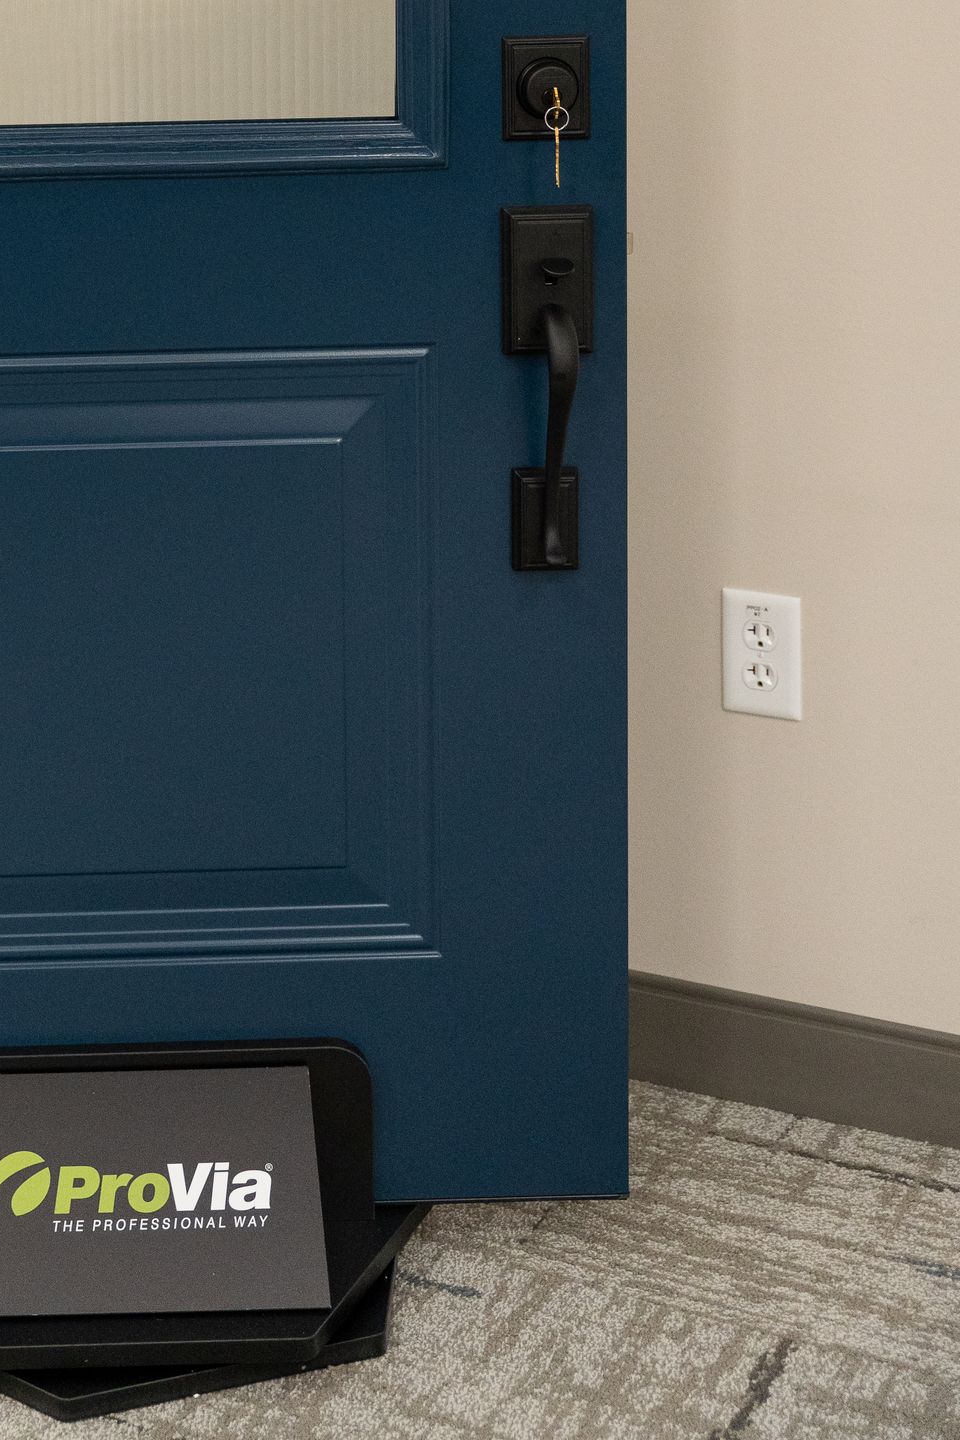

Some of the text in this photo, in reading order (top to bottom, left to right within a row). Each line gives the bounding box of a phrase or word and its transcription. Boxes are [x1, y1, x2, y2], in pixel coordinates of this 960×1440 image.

[52, 1214, 269, 1233] THE PROFESSIONAL WAY
